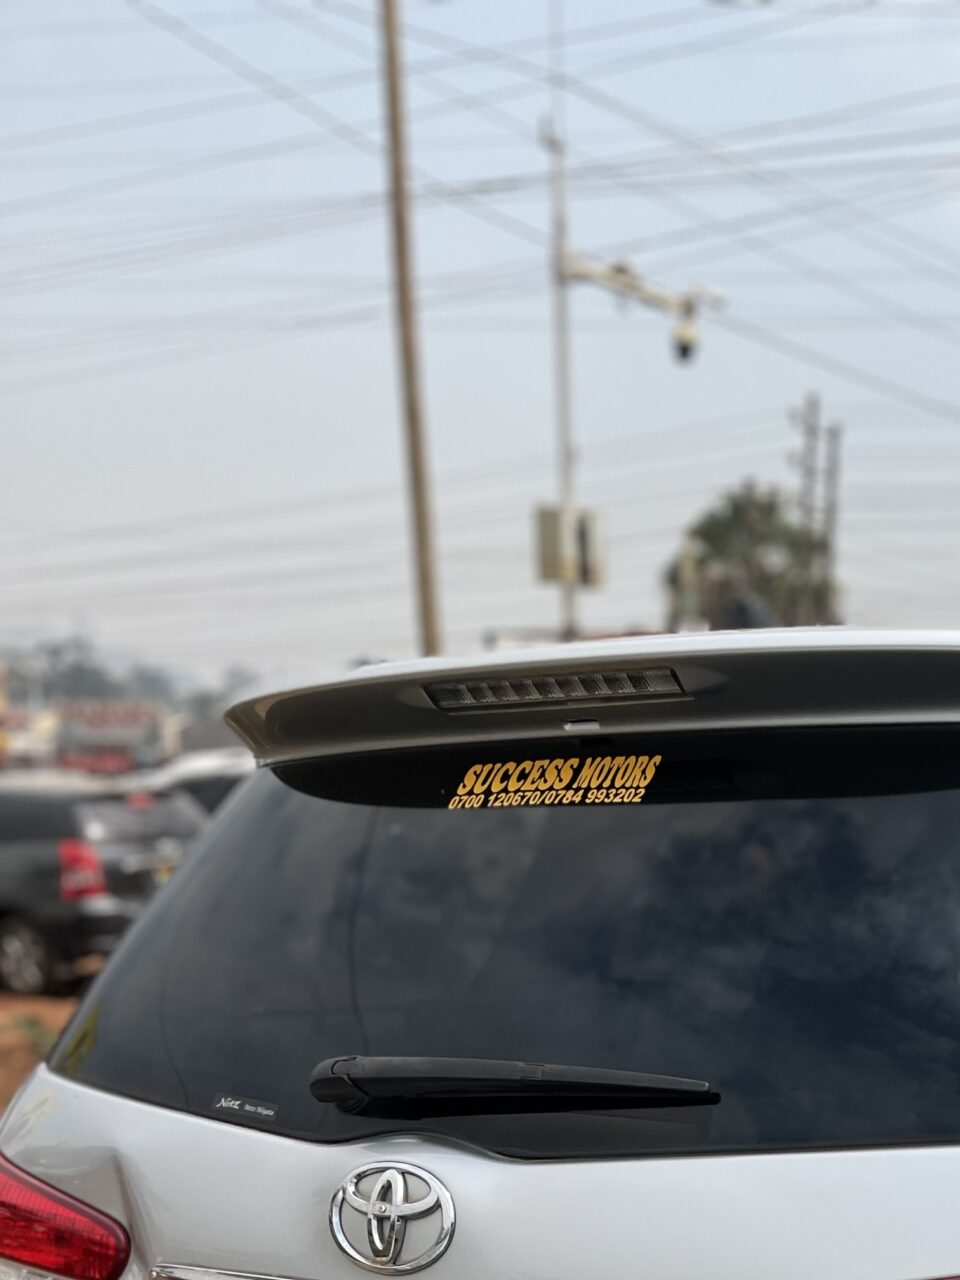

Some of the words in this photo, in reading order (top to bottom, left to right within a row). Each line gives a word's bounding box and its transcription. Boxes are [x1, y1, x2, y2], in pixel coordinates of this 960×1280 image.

[457, 759, 579, 795] SUCCESS
[572, 755, 662, 789] MOTORS
[448, 795, 484, 809] 0700
[487, 789, 582, 807] 120670/0784
[585, 789, 645, 803] 993202
